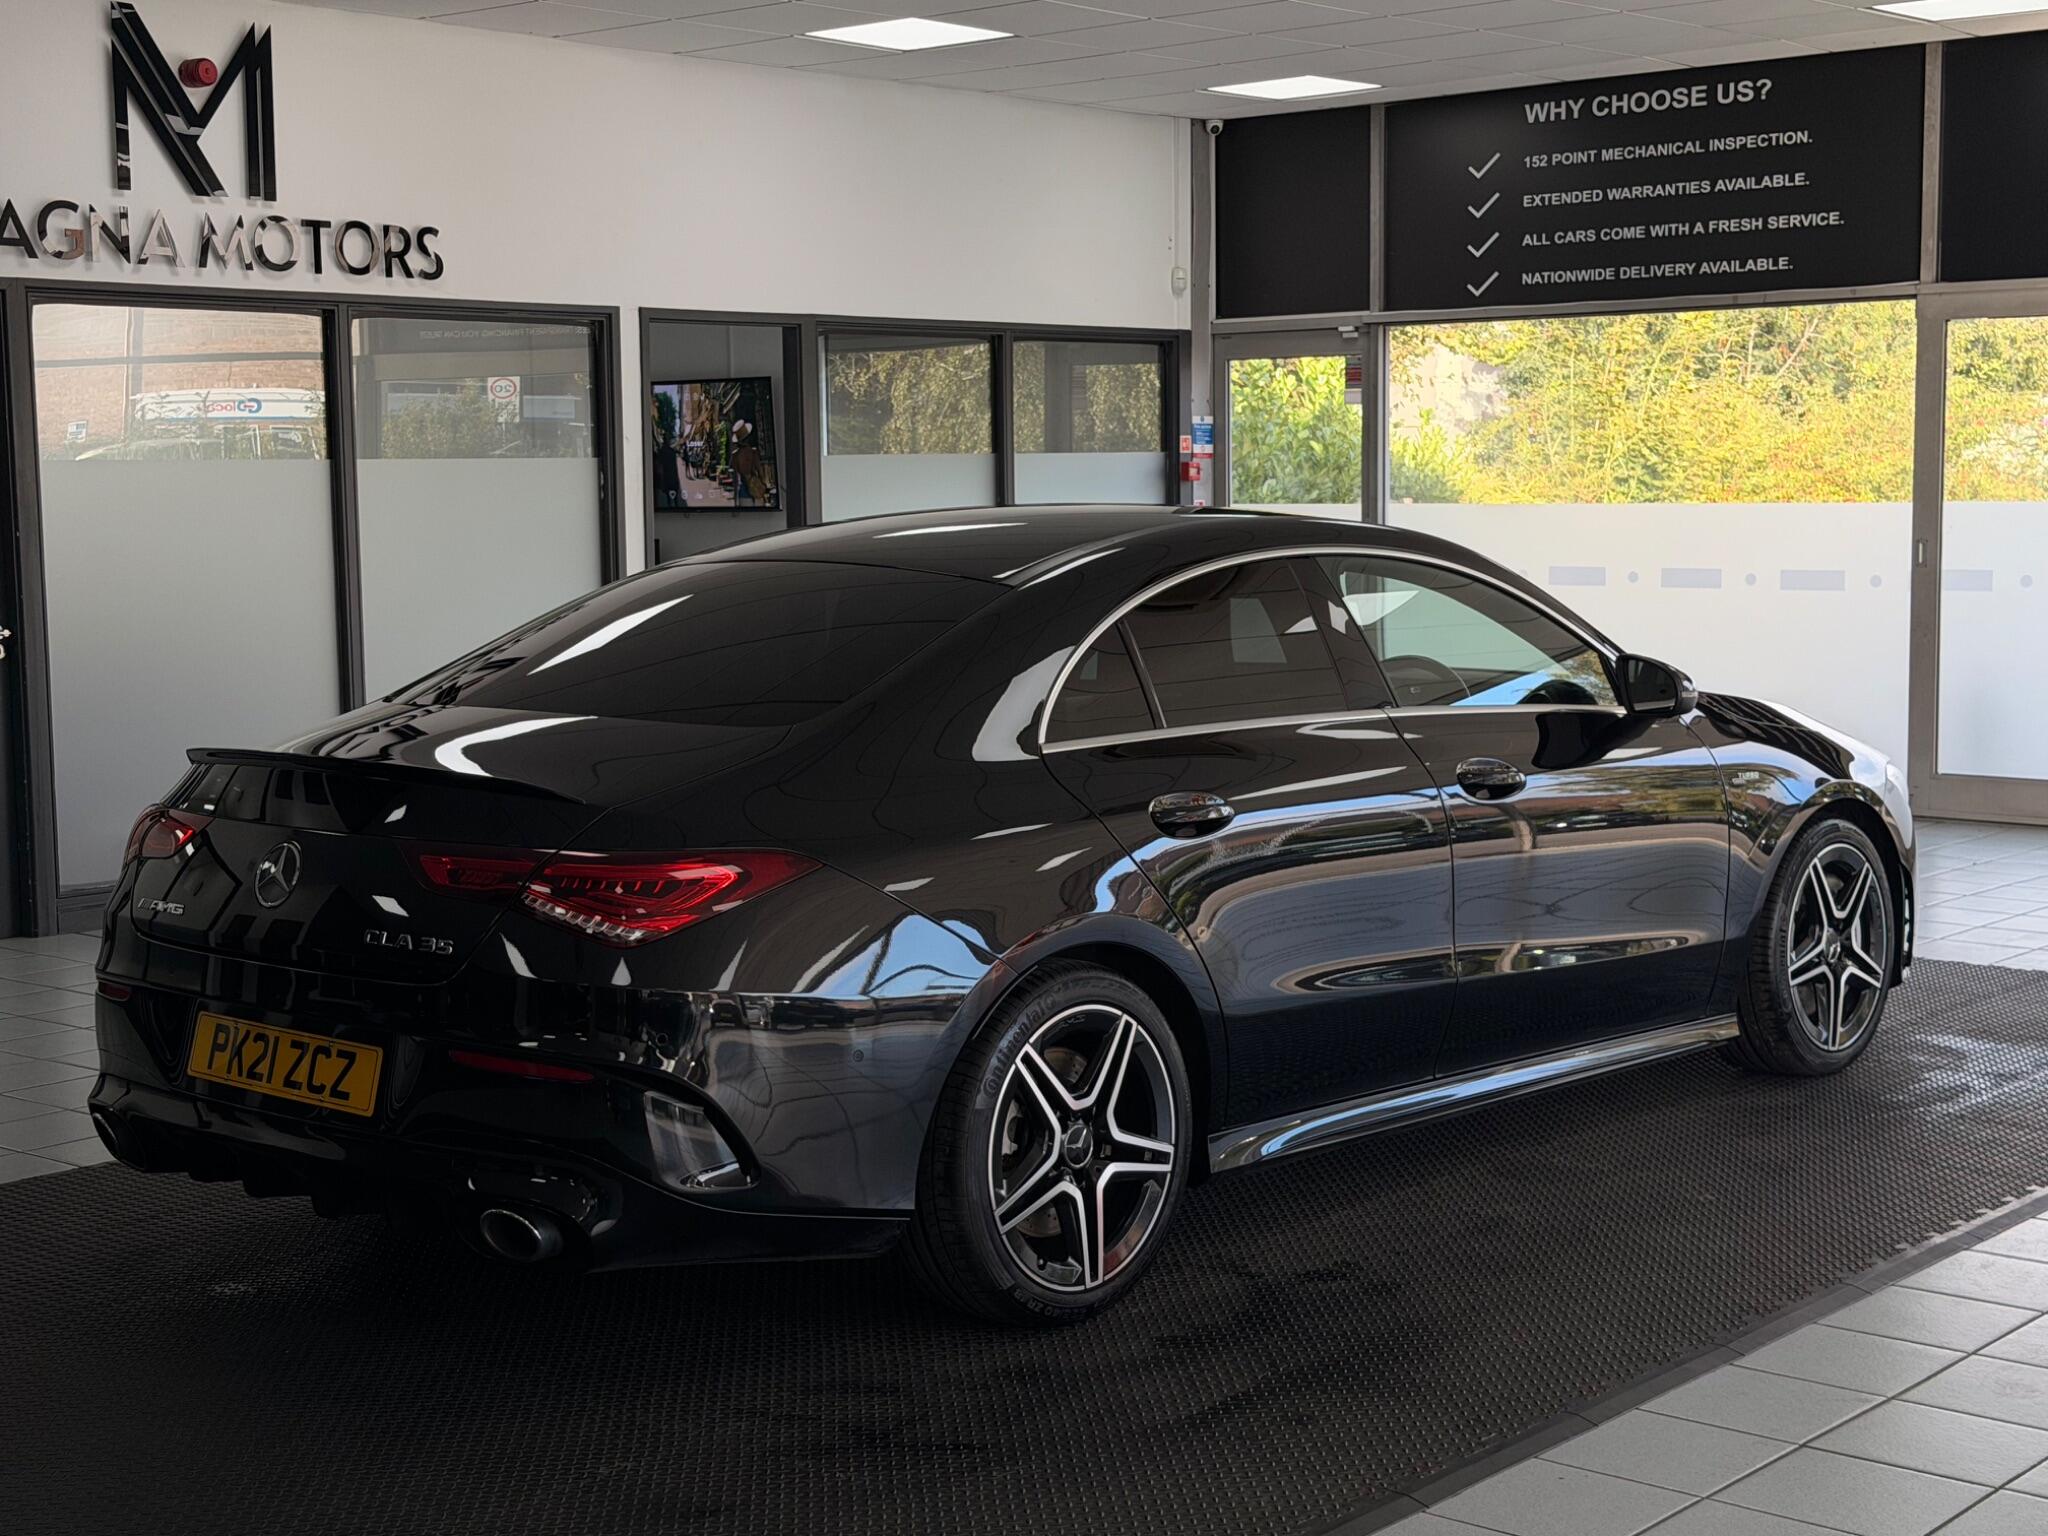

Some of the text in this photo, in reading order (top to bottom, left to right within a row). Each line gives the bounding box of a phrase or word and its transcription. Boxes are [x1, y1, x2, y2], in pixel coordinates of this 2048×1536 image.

[1524, 78, 1773, 124] WHY CHOOSE US?
[1524, 130, 1813, 168] 152 POINT MECHANICAL INSPECTION.
[1523, 172, 1810, 208] EXTENDED WARRANTIES AVAILABLE.
[199, 212, 444, 281] MOTORS
[1522, 211, 1845, 247] ALL CARS COME WITH A FRESH SERVICE.
[1521, 256, 1794, 285] NATIONWIDE DELIVERY AVAILABLE.
[149, 900, 185, 914] AMG
[363, 928, 454, 955] CLA 35
[208, 1023, 357, 1101] PK21 ZCZ
